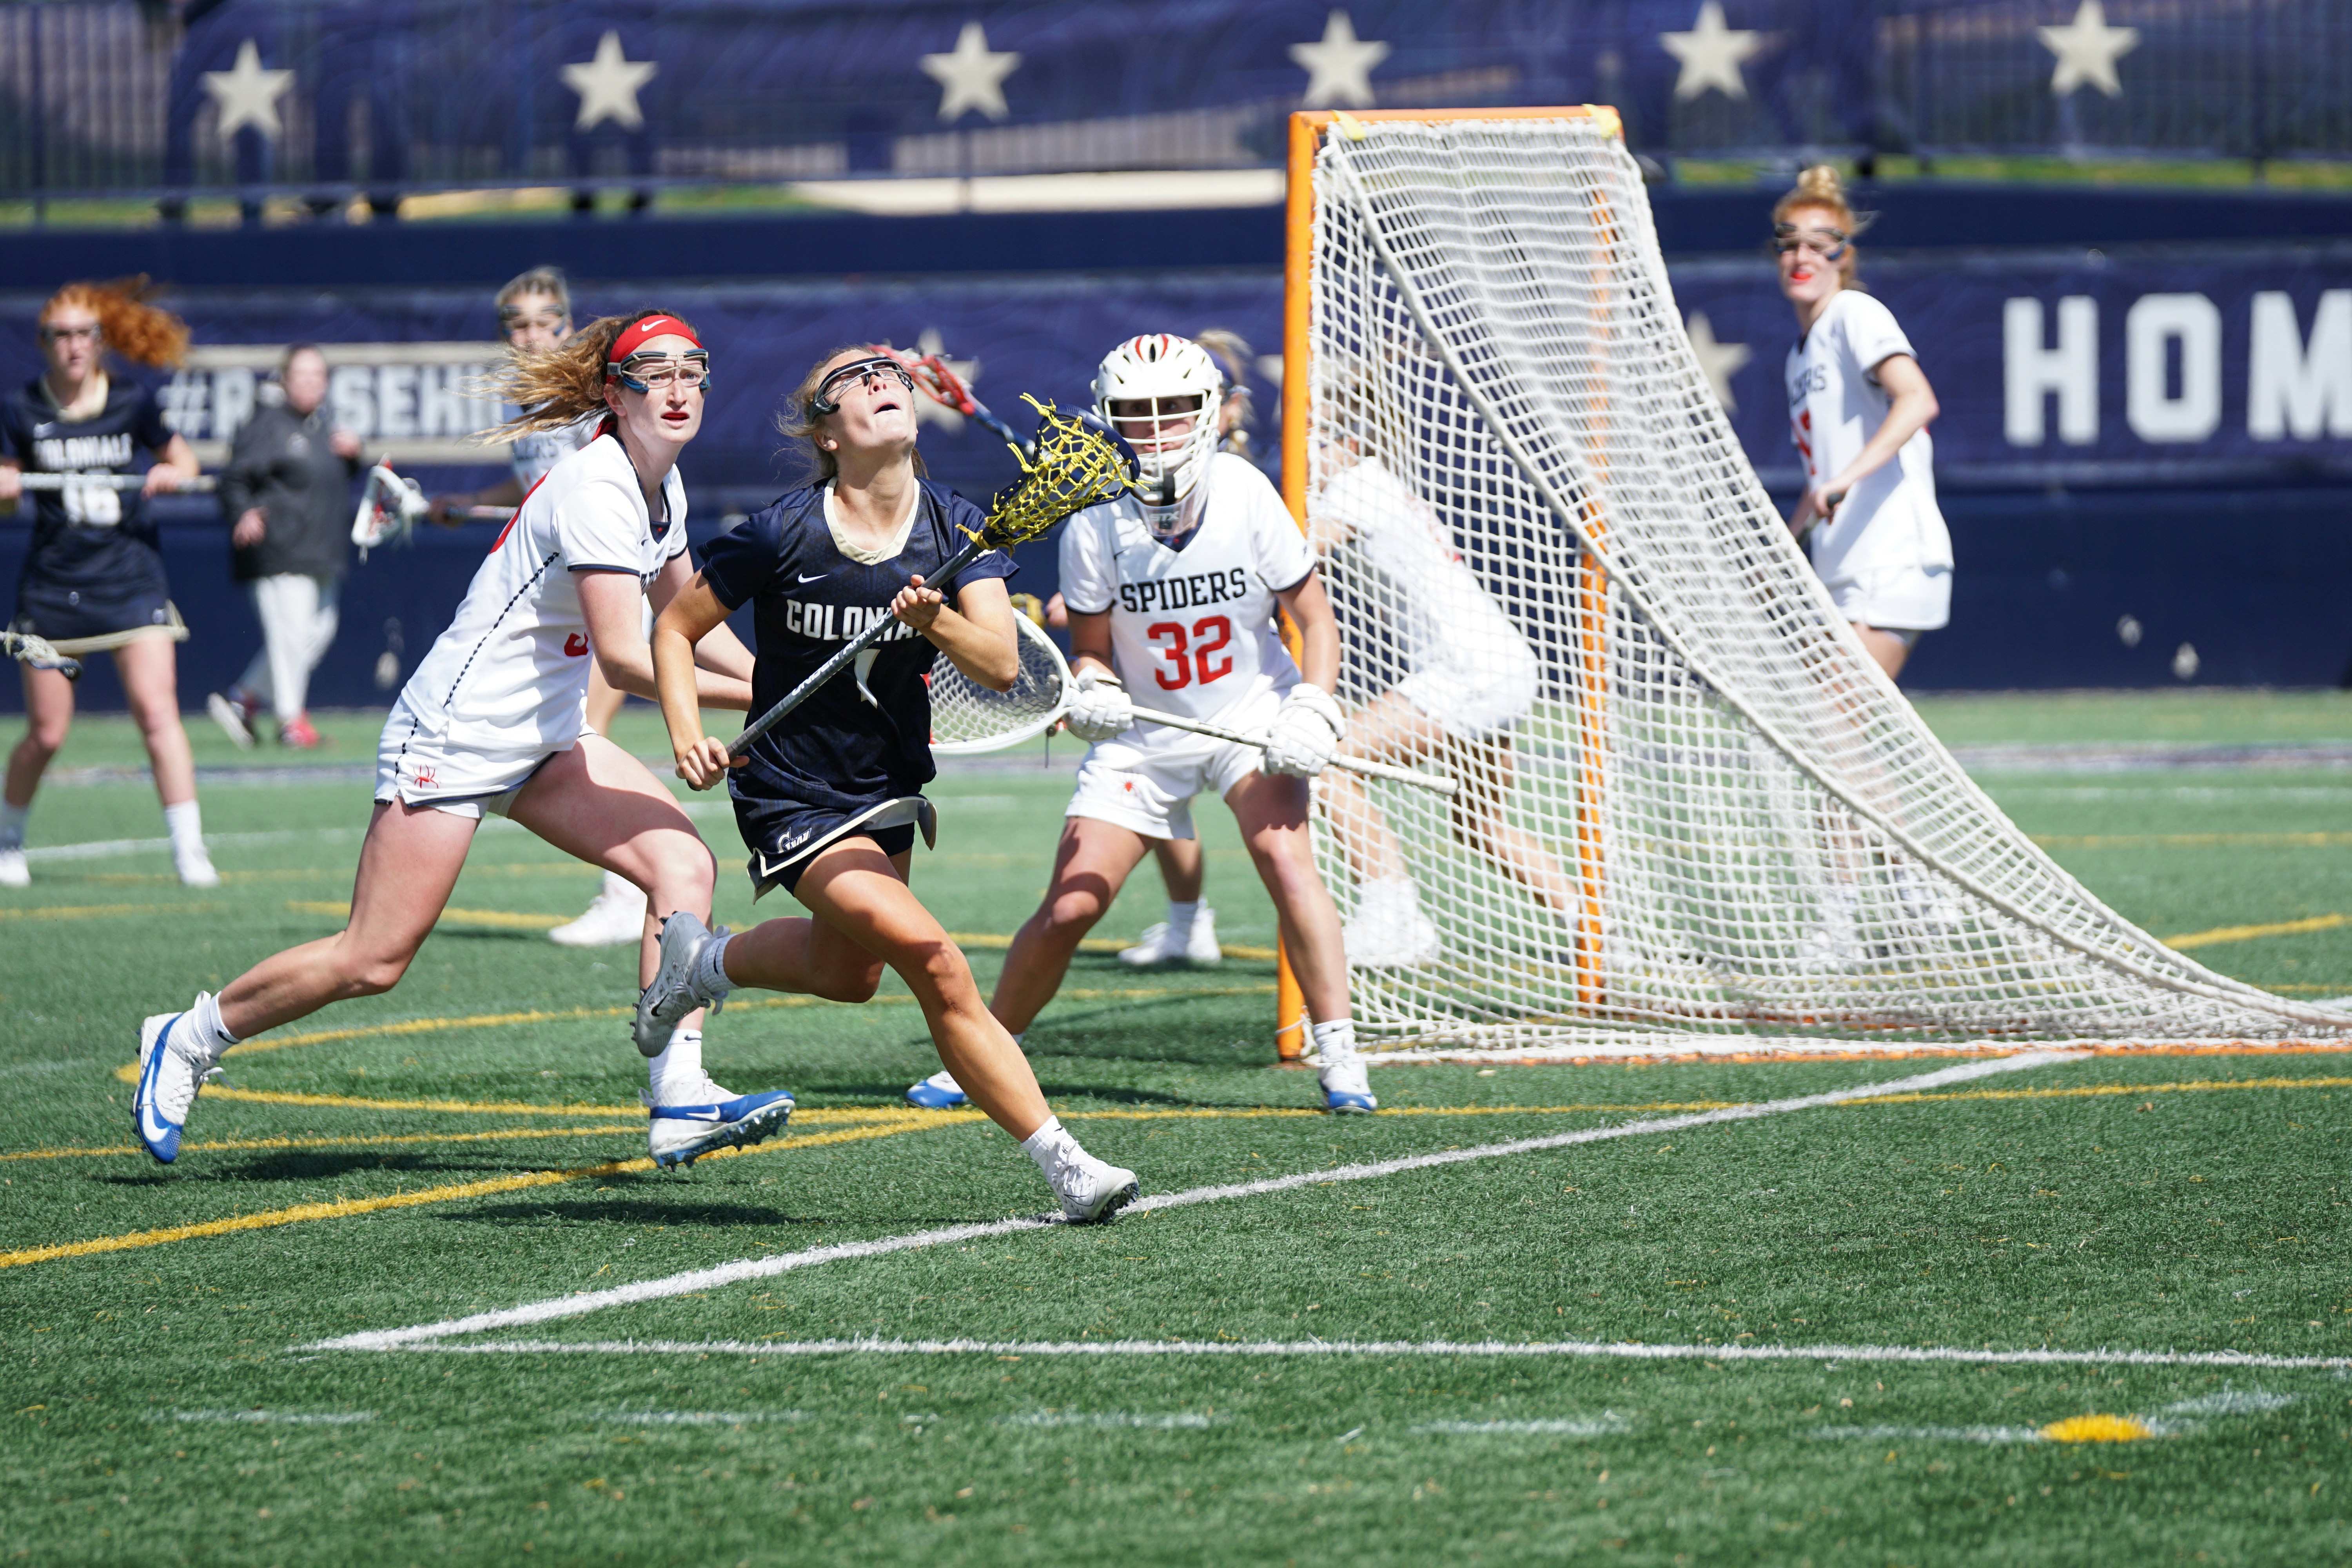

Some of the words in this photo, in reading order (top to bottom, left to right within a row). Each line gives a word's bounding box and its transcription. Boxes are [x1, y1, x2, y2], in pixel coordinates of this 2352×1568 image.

[1120, 566, 1247, 613] SPIDERS
[786, 599, 923, 642] COLONIA
[791, 652, 840, 696] UNDER
[1147, 614, 1232, 691] 32
